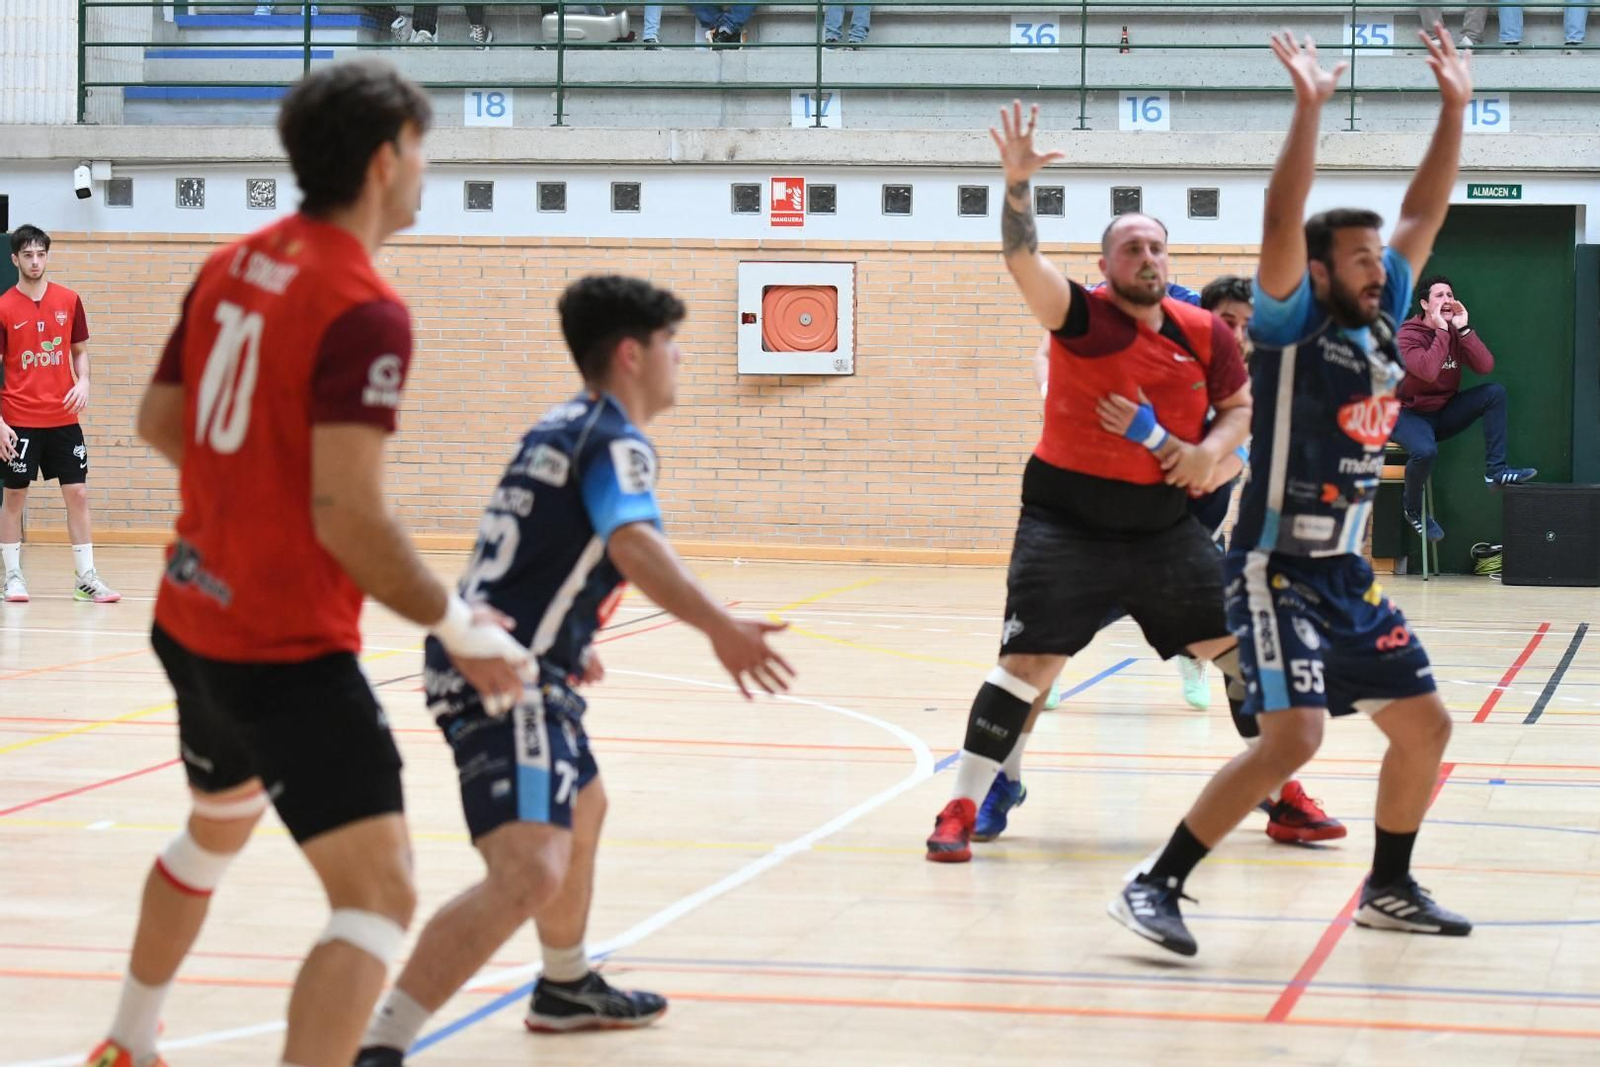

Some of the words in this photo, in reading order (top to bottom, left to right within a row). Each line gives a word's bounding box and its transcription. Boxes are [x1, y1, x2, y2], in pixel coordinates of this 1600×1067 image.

[1015, 23, 1056, 45] 36
[1350, 23, 1390, 46] 35
[471, 91, 506, 118] 18
[799, 92, 833, 118] 17
[1126, 96, 1163, 123] 16
[1468, 98, 1502, 126] 15
[1472, 187, 1509, 197] ALMACEN
[1511, 187, 1518, 197] 4
[21, 350, 63, 370] Proin
[195, 300, 264, 454] 10
[1290, 659, 1325, 694] 55
